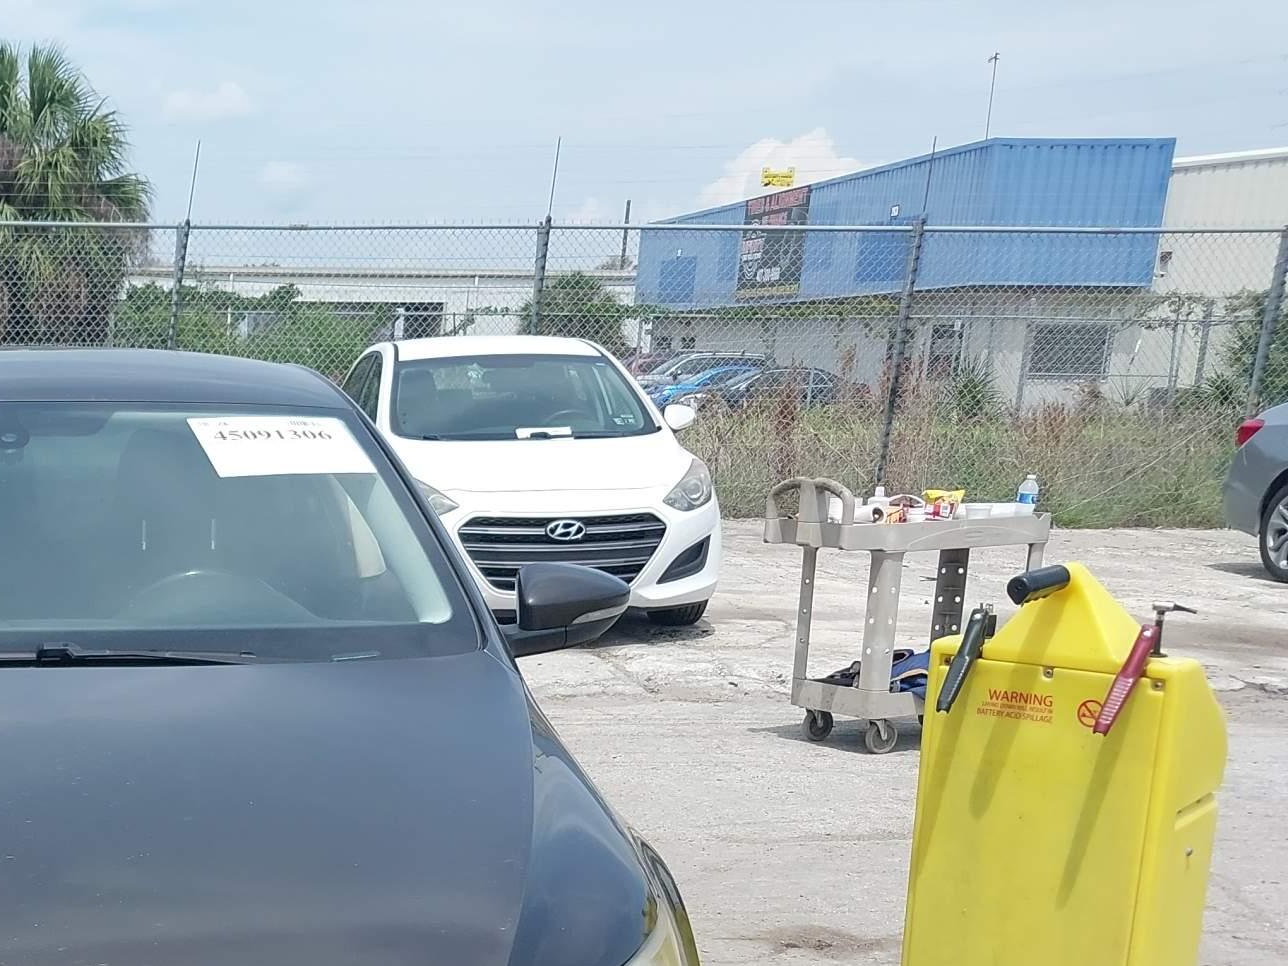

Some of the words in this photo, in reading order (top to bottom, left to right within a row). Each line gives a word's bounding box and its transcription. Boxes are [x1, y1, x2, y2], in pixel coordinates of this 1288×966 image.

[213, 429, 333, 441] 45091306
[988, 688, 1053, 707] WARNING
[976, 708, 1005, 718] BATTERY
[1005, 711, 1022, 720] ACID
